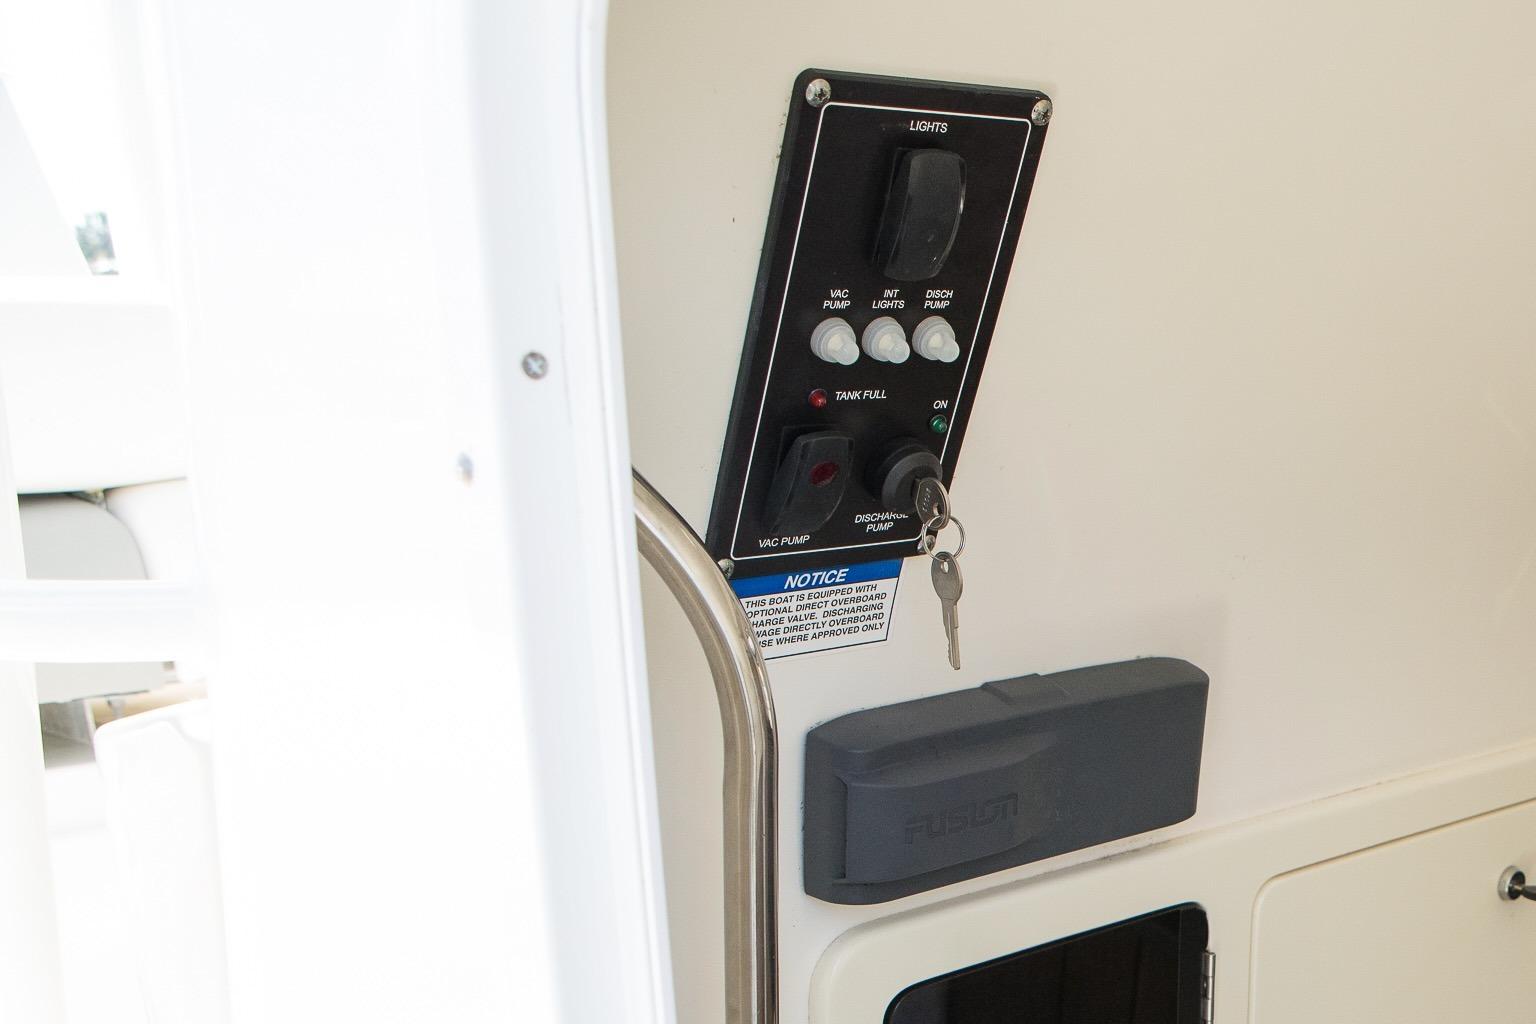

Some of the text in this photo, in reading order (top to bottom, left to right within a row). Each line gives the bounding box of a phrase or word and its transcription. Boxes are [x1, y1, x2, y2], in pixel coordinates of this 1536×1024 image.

[909, 120, 948, 133] LIGHTS
[830, 289, 849, 298] VAC
[883, 289, 899, 298] INT
[926, 289, 953, 299] DISCH
[823, 300, 850, 309] PUMP
[872, 300, 905, 309] LIGHTS
[924, 300, 950, 309] PUMP
[835, 389, 887, 401] TANK FULL
[933, 400, 948, 409] ON
[866, 521, 894, 533] PUMP
[758, 534, 810, 548] VAC PUMP
[783, 568, 850, 590] NOTICE
[745, 584, 877, 609] THIS BOAT IS EQUIPPED WITH
[746, 592, 887, 619] OPTIONAL DIRECT OVERBOARD
[751, 602, 884, 628] HARGE VALVE. DISCHARGING
[755, 612, 884, 638] WAGE DIRECTLY OVERBOARD
[776, 633, 809, 646] WHERE
[811, 625, 860, 641] APPROVED
[861, 621, 885, 633] ONLY
